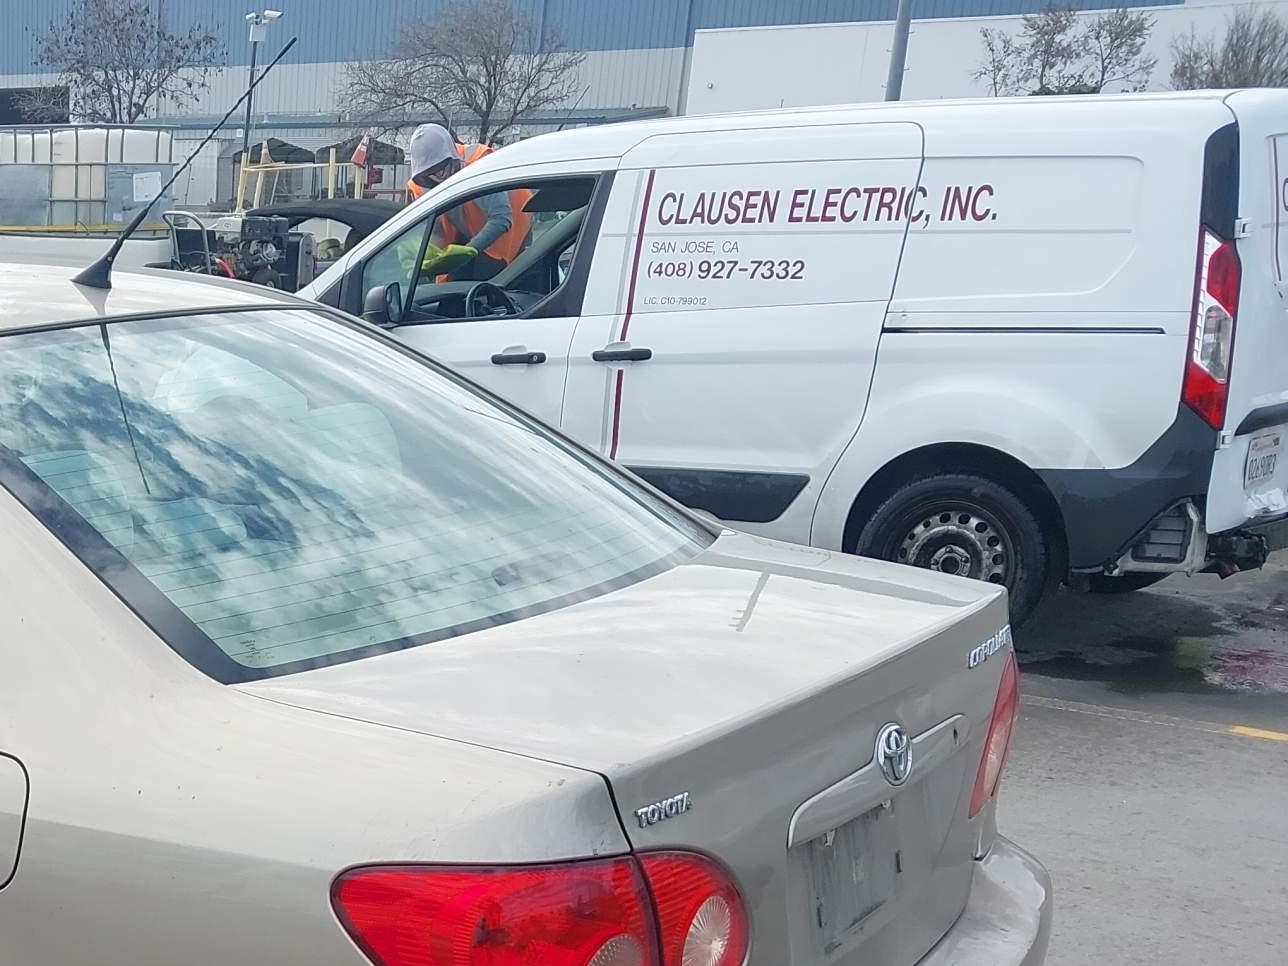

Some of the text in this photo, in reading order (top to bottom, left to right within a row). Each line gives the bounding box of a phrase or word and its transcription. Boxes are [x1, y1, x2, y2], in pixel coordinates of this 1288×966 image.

[657, 184, 998, 230] CLAUSEN ELECTRIC, INC.
[650, 240, 740, 255] SAN JOSE, CA
[647, 259, 806, 280] (408) 927-7332
[634, 791, 692, 829] TOYOTA
